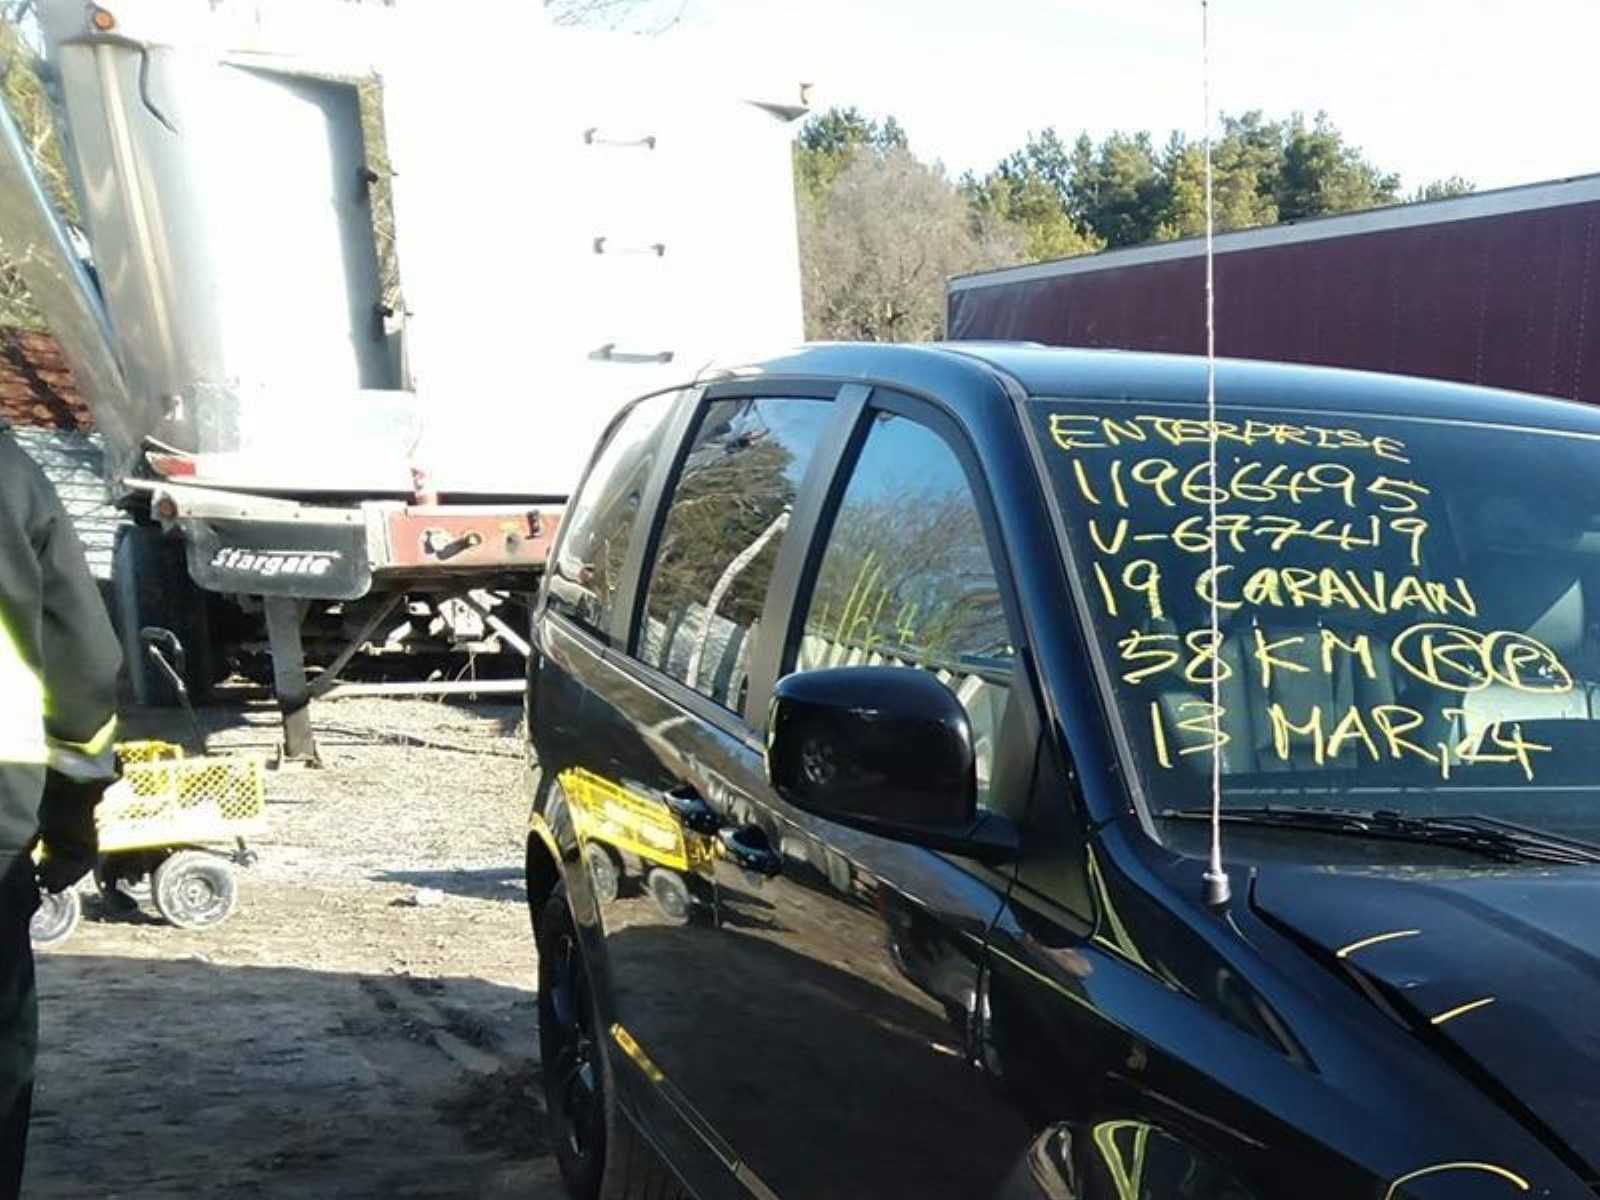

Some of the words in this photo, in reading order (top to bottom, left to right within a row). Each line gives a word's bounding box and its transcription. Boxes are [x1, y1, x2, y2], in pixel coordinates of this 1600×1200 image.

[1048, 412, 1411, 464] ENTERPRISE
[1072, 458, 1430, 512] 11966495
[210, 548, 336, 577] Stargate
[1095, 559, 1165, 621] 19
[1195, 565, 1477, 617] CARAVAN
[1117, 629, 1233, 684] 58
[1151, 701, 1232, 768] 13
